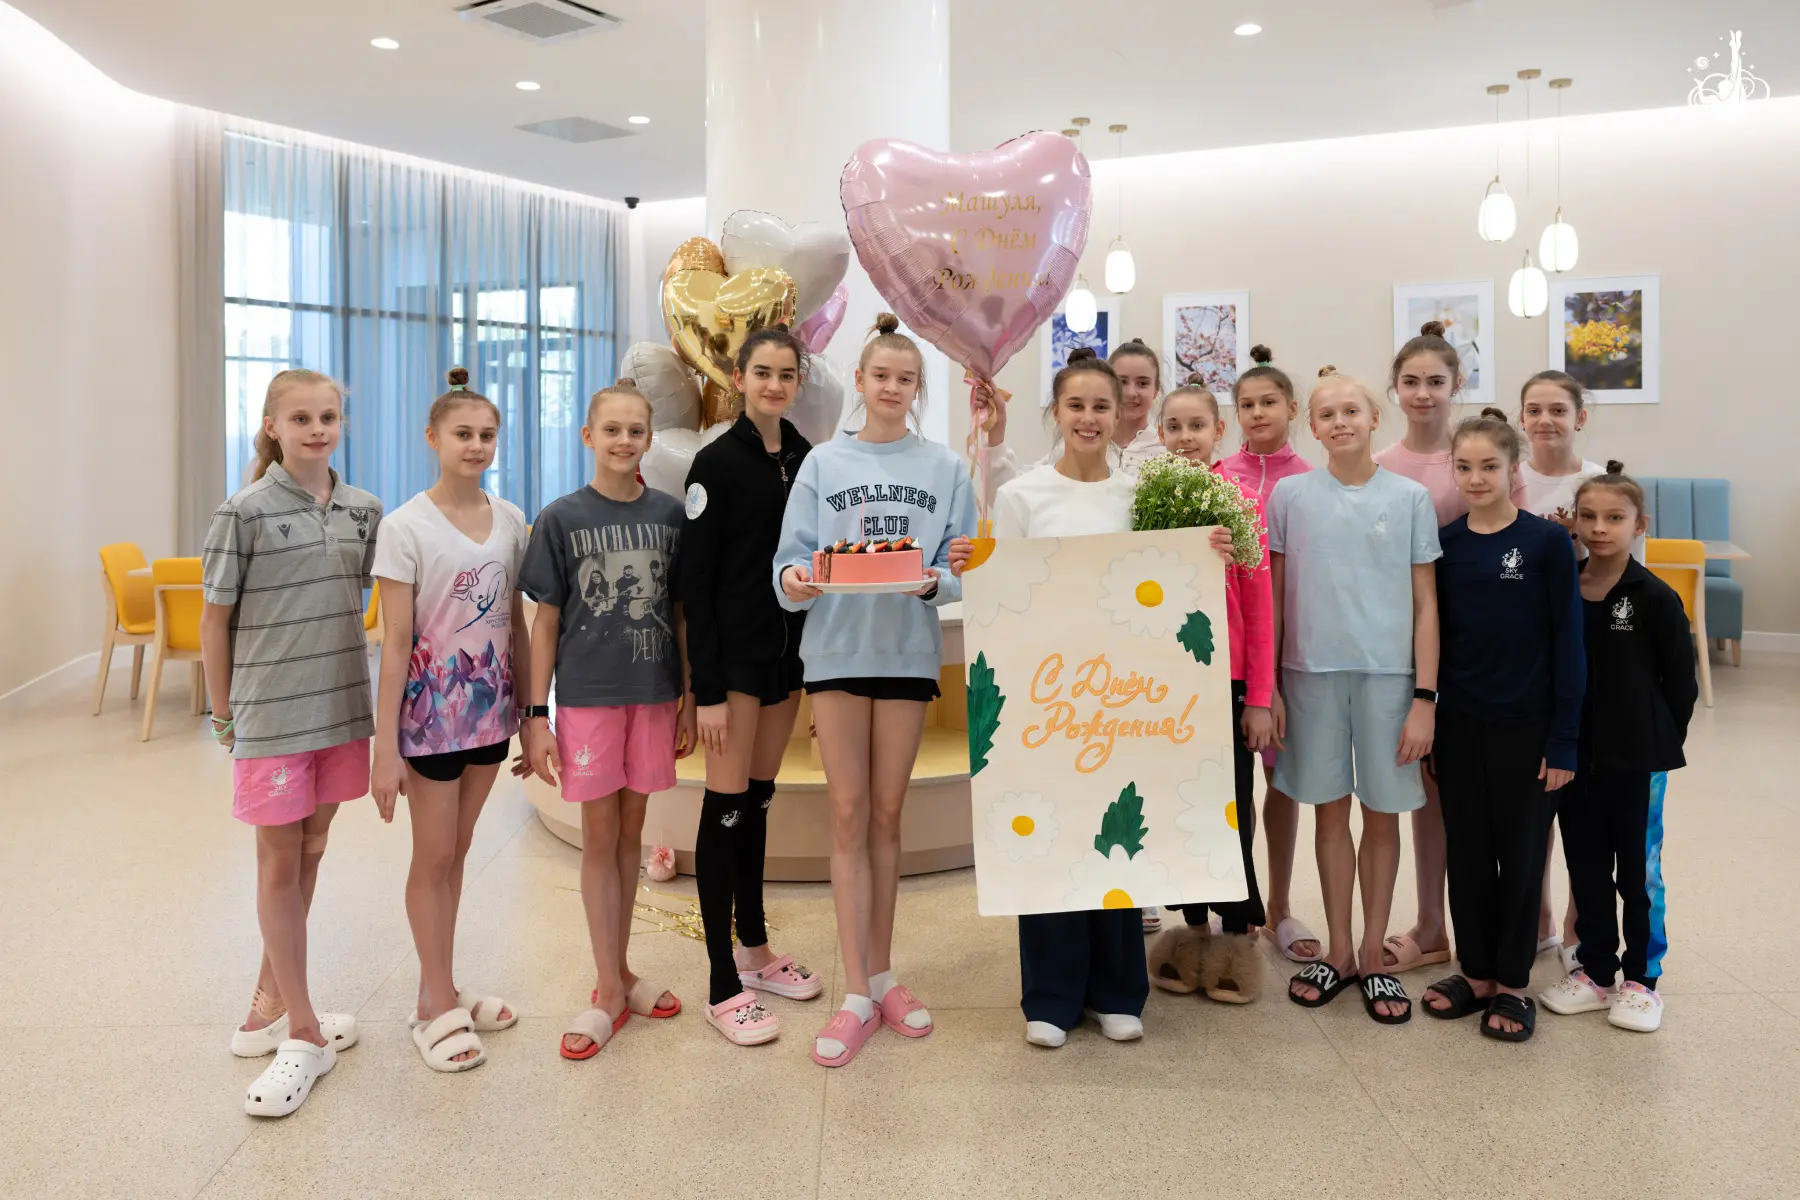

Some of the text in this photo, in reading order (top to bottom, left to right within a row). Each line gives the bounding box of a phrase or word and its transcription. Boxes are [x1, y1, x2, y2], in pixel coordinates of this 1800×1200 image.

[826, 484, 937, 513] WELLNESS
[861, 516, 909, 536] CLUB
[570, 524, 634, 558] UDACHA
